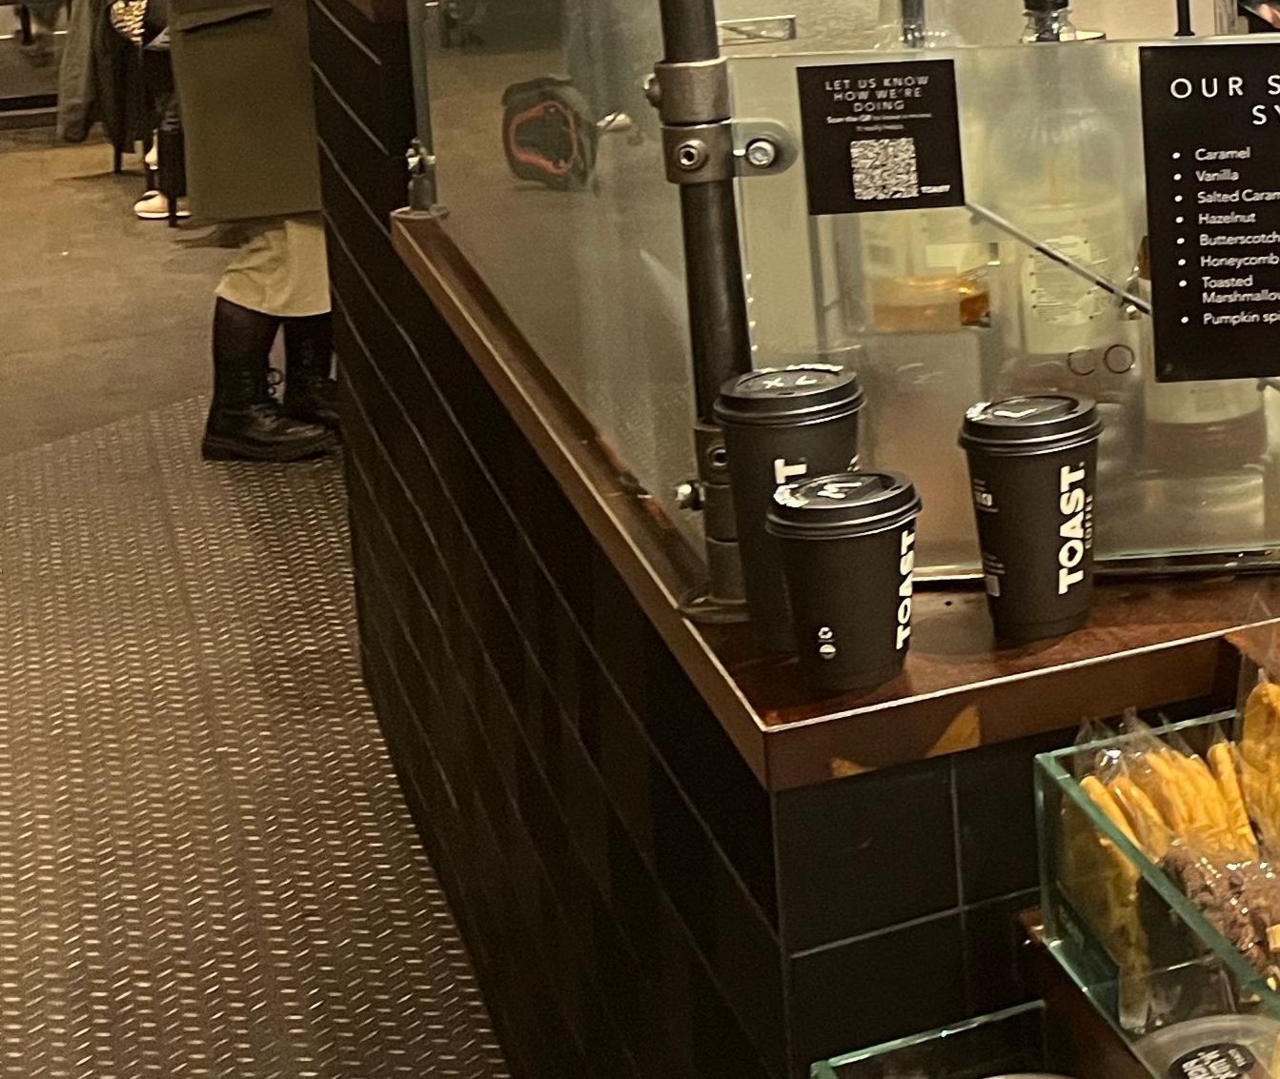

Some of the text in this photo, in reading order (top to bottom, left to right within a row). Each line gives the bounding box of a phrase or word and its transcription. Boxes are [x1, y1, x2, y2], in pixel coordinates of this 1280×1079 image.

[825, 76, 929, 91] LET US KNOW
[1170, 76, 1244, 100] OUR
[834, 91, 869, 101] HOW
[853, 100, 905, 112] DOING
[1195, 147, 1251, 162] Caramel
[1195, 169, 1240, 182] Vanilla
[1197, 190, 1240, 204] Salted
[1198, 210, 1256, 225] Hazelnut
[1200, 253, 1280, 270] Honeycomb
[1202, 274, 1254, 289] Toasted
[1203, 311, 1260, 327] Pumpkin
[1058, 465, 1086, 596] TOAST
[895, 530, 917, 651] TOAST
